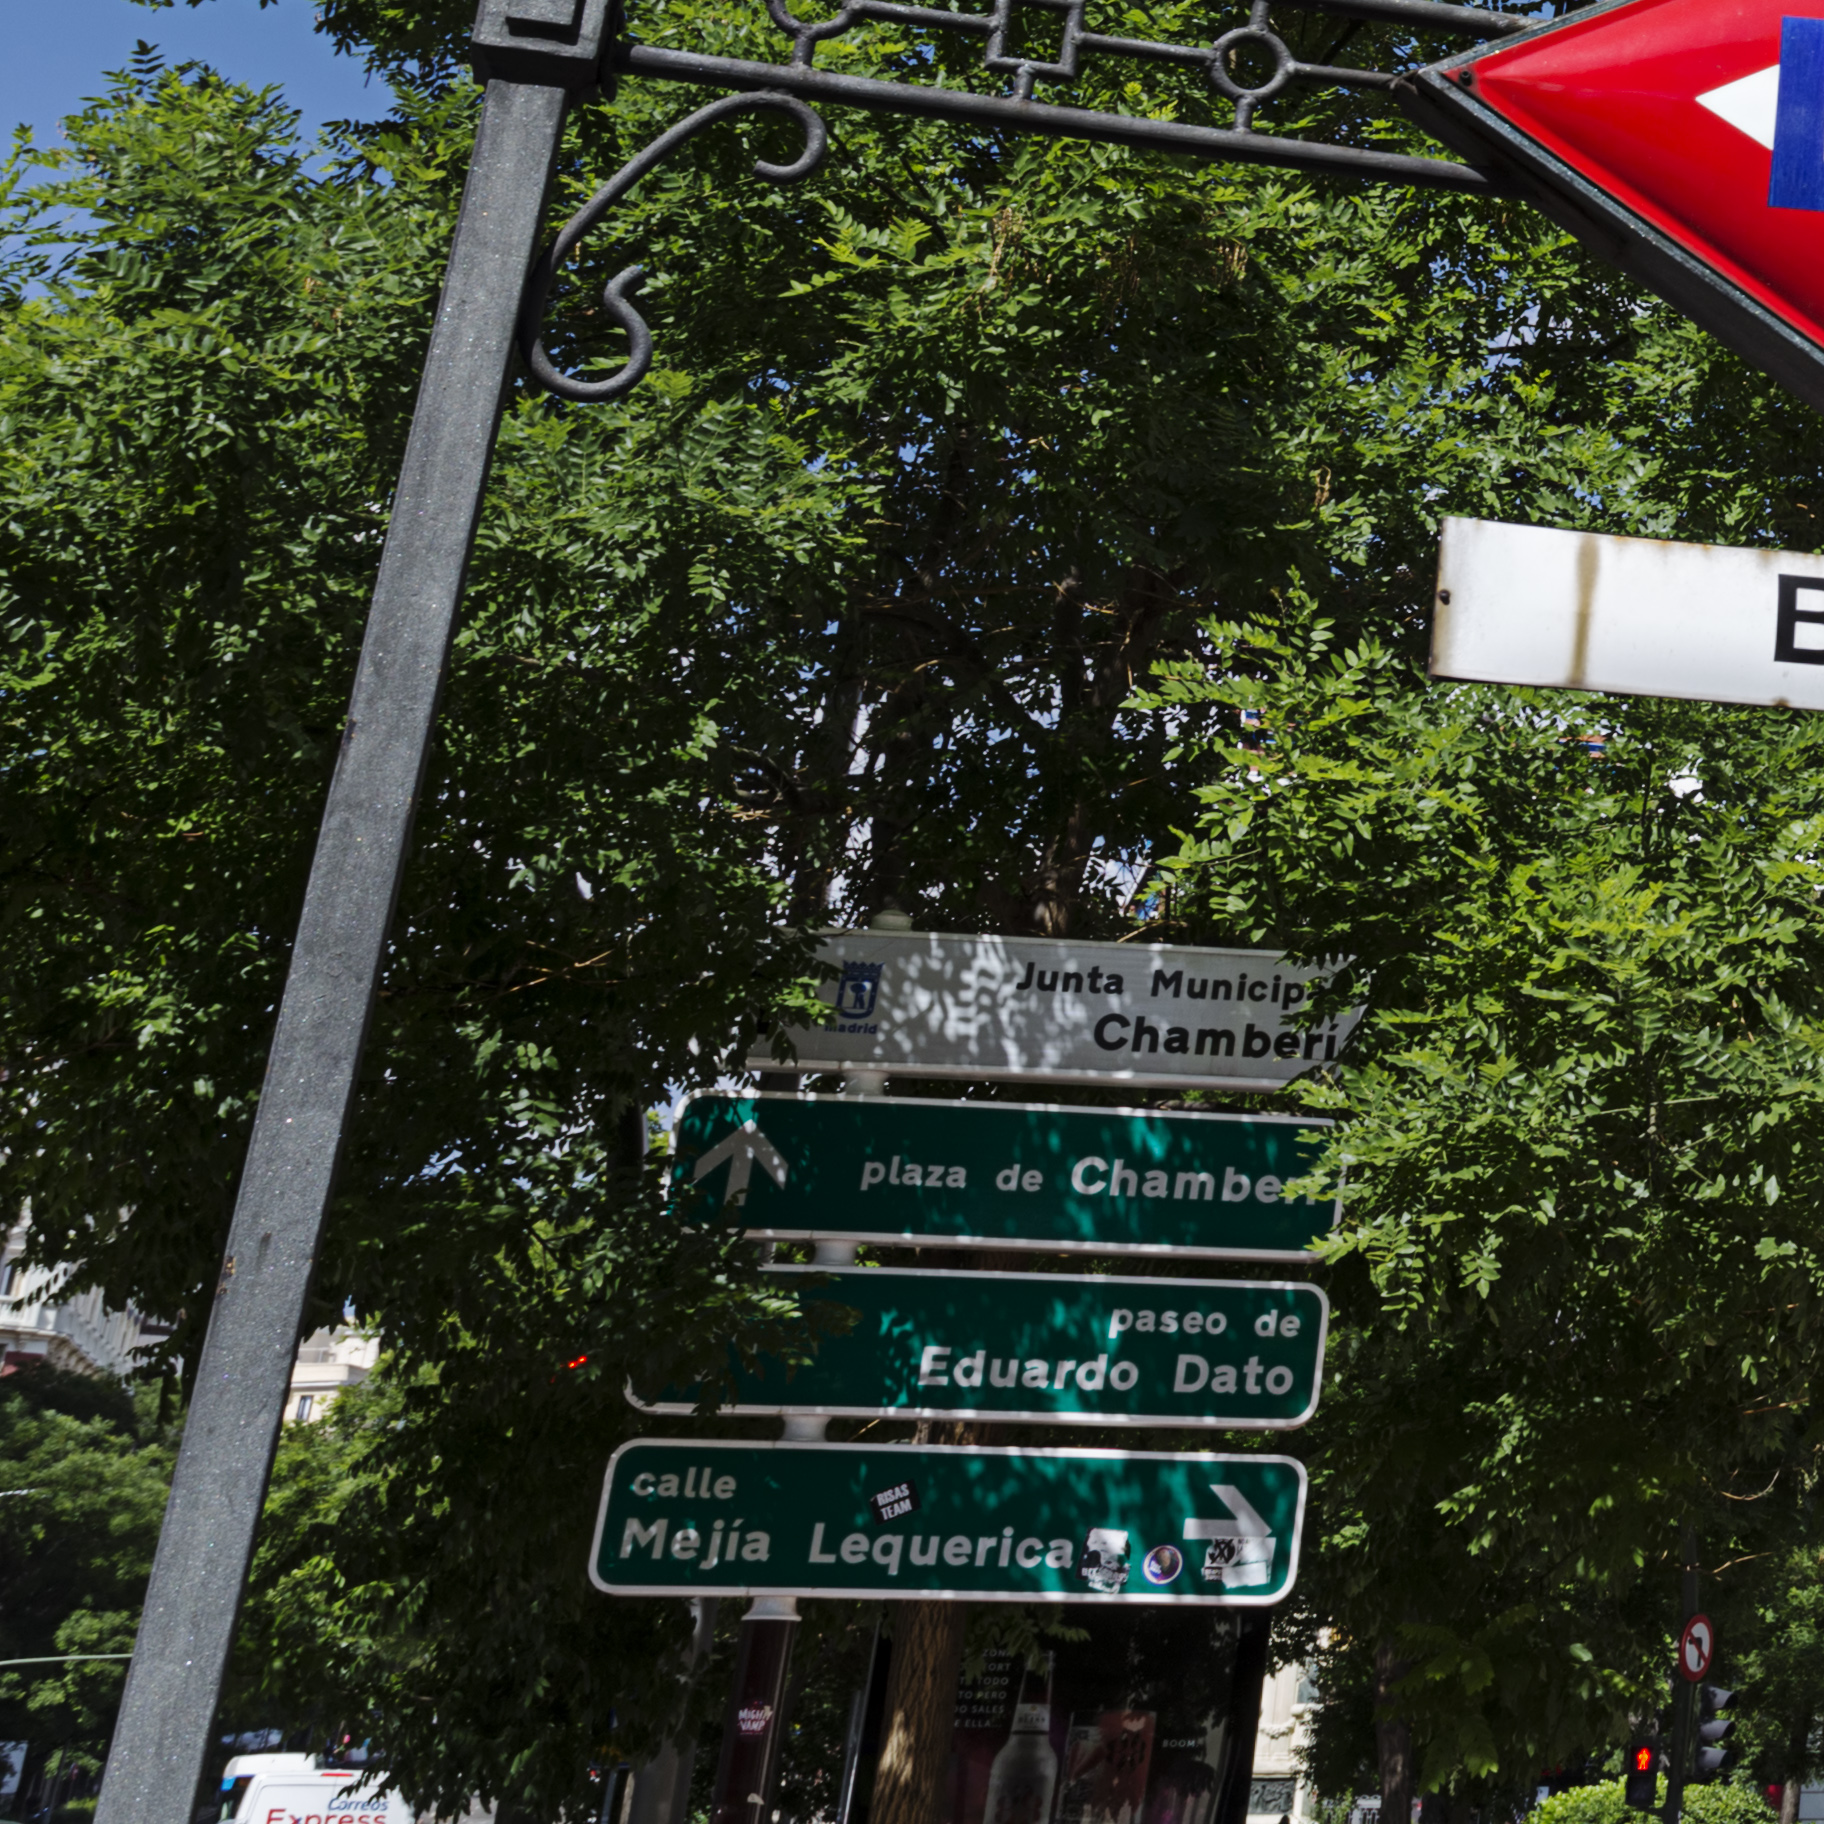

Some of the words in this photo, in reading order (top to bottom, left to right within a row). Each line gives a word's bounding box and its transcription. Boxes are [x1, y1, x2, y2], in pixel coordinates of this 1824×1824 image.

[1016, 961, 1124, 996] Junta
[1151, 969, 1328, 1010] Municip
[1094, 1013, 1340, 1062] Chamberí
[861, 1157, 967, 1191] plaza
[996, 1163, 1043, 1192] de
[1071, 1156, 1316, 1206] Chambe
[1109, 1307, 1227, 1338] paseo
[1254, 1308, 1301, 1338] de
[919, 1345, 1140, 1392] Eduardo
[1174, 1353, 1294, 1396] Dato
[632, 1465, 737, 1500] calle
[876, 1483, 911, 1506] RISAS
[880, 1498, 913, 1521] TEAM
[619, 1517, 770, 1570] Mejía
[809, 1522, 1074, 1575] Lequerica
[971, 1704, 1006, 1713] SALES
[328, 1797, 390, 1811] Correos
